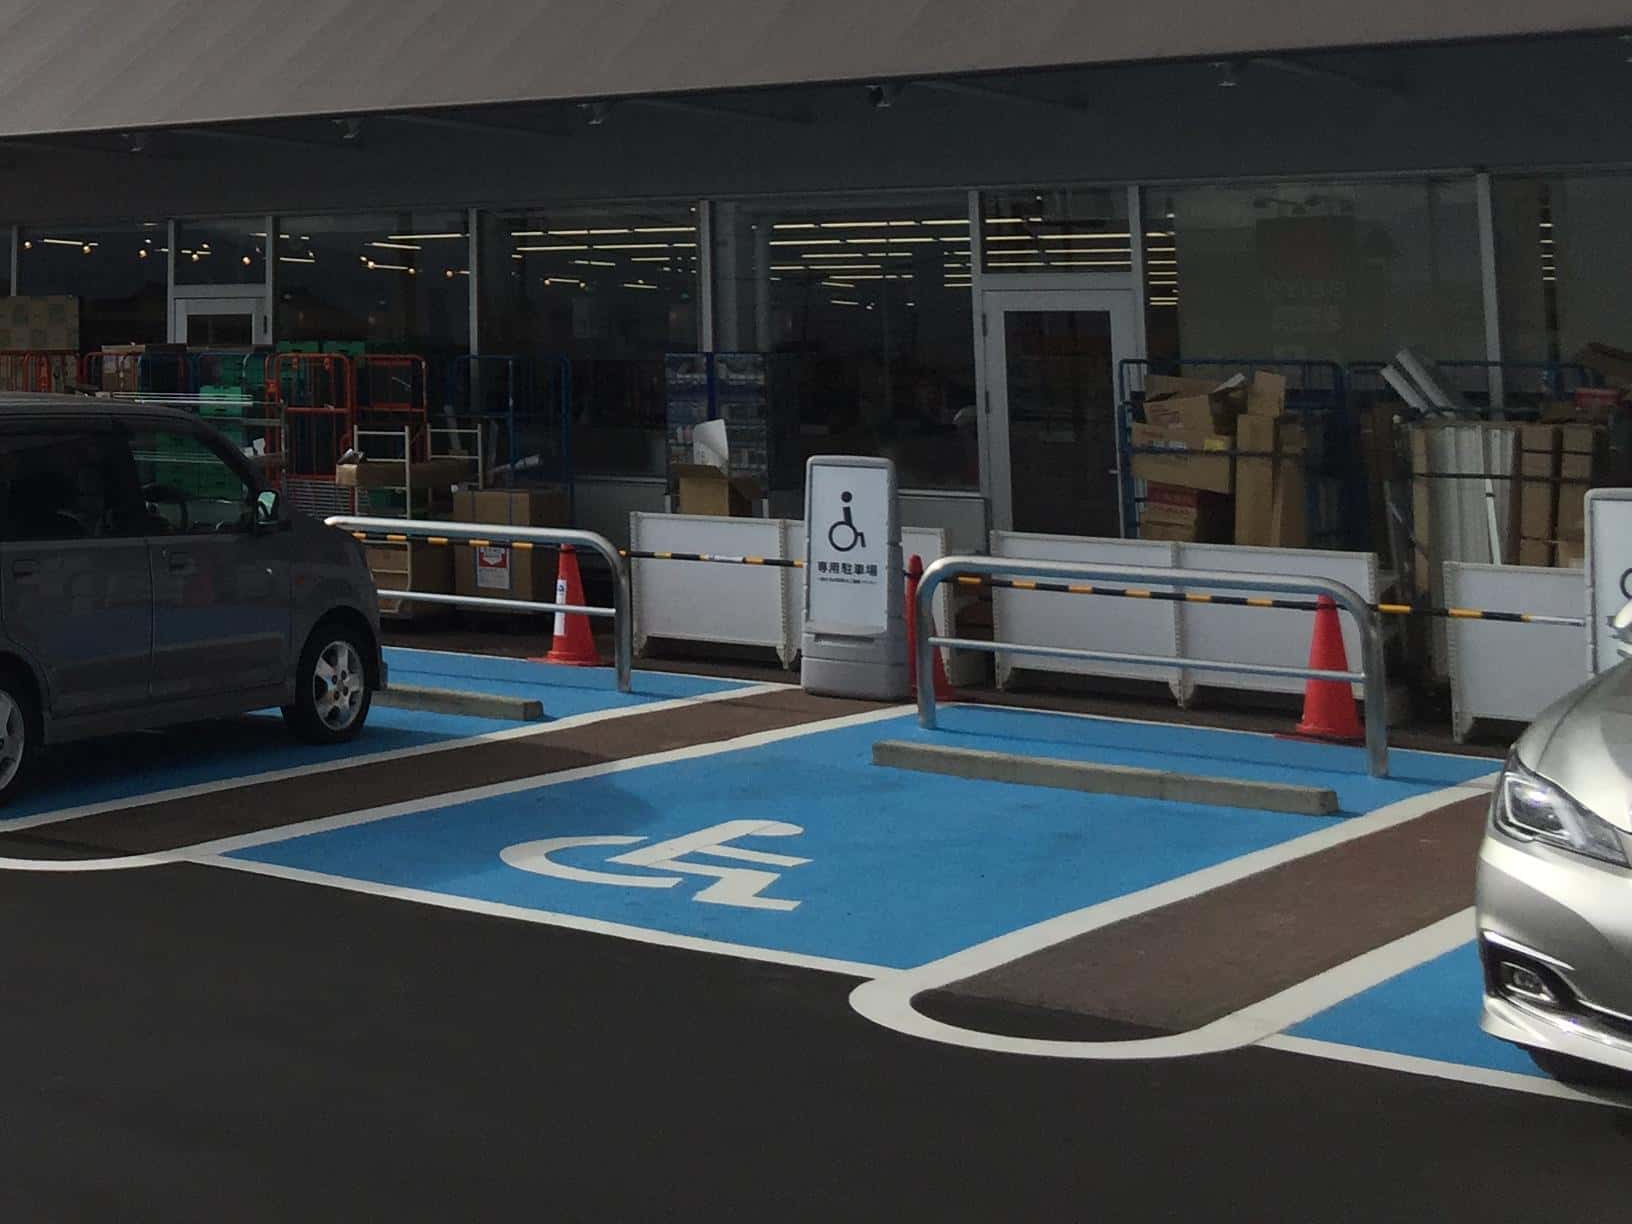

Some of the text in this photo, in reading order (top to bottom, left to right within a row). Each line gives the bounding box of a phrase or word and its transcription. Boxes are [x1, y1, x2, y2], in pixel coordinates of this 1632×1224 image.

[817, 561, 878, 577] 専用駐車場
